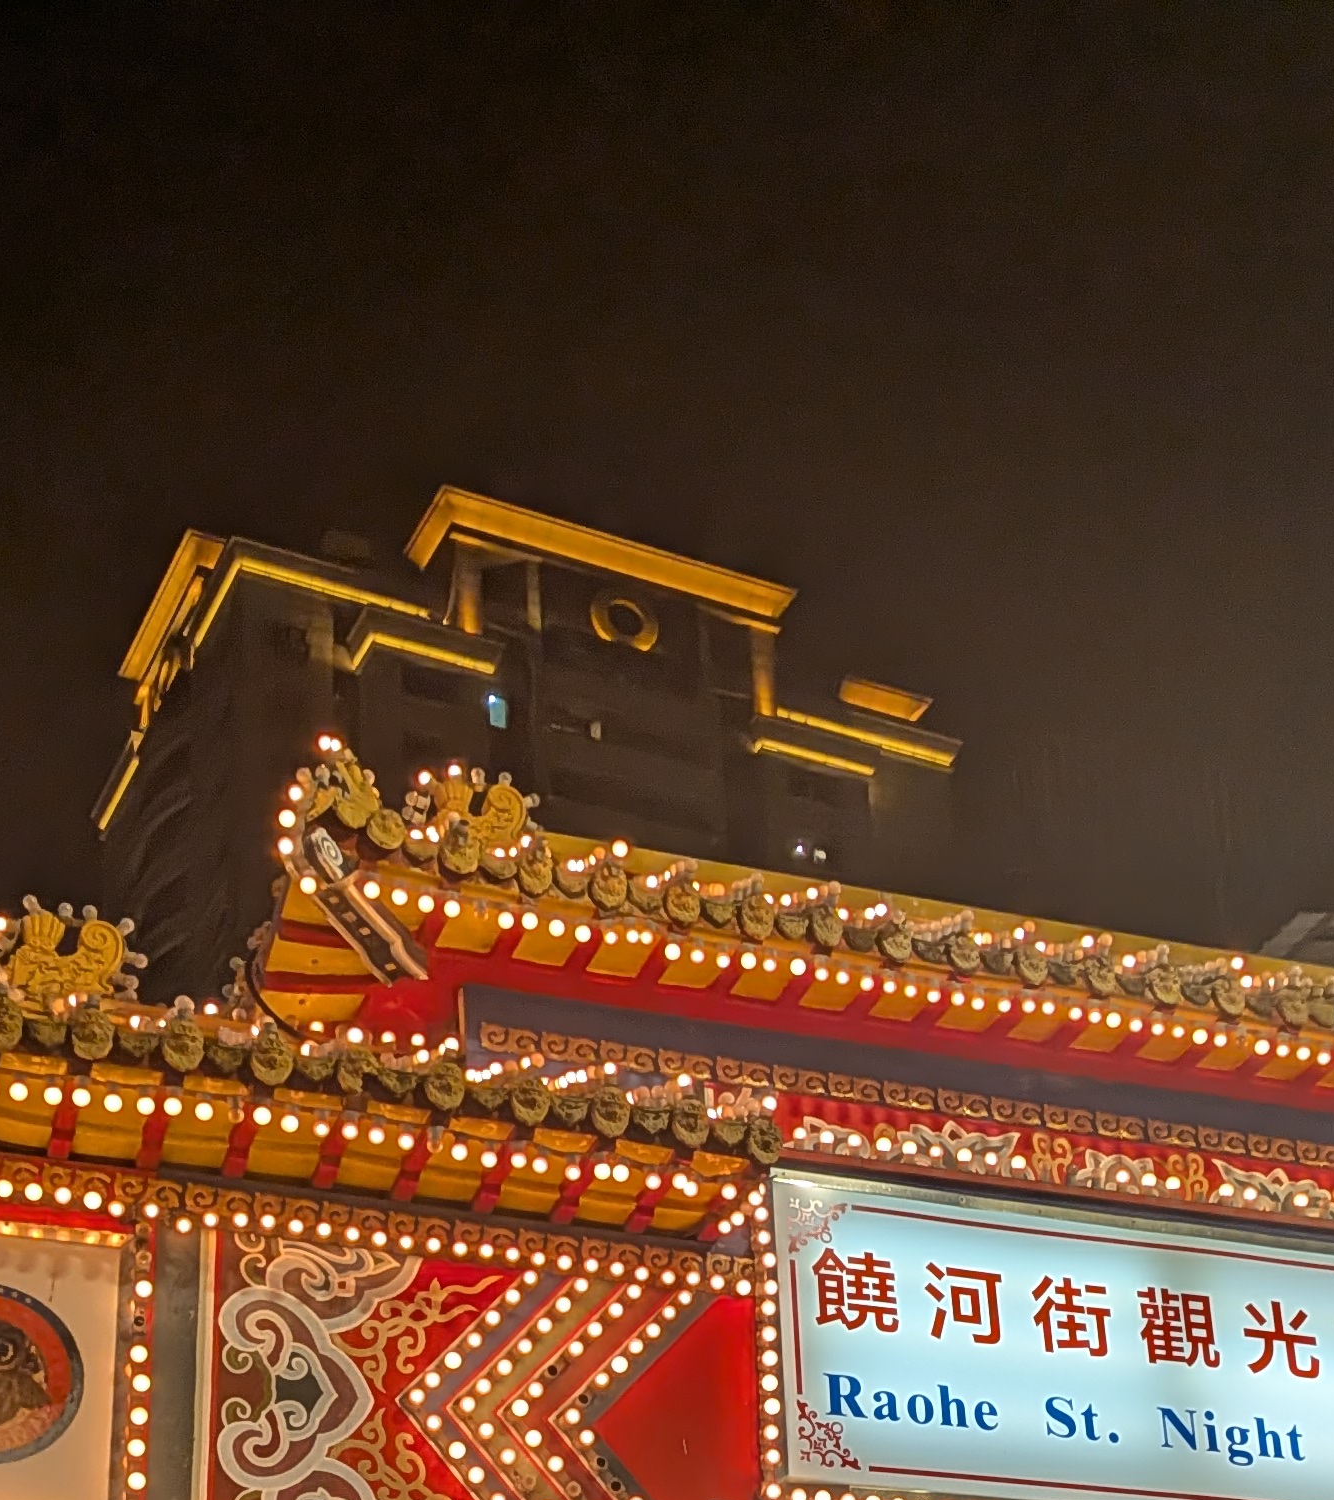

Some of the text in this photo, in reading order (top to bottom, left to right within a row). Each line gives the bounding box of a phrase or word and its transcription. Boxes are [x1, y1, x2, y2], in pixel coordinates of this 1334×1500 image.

[822, 1373, 1000, 1431] Raohe
[1045, 1395, 1120, 1445] St.
[1160, 1406, 1307, 1468] Night
